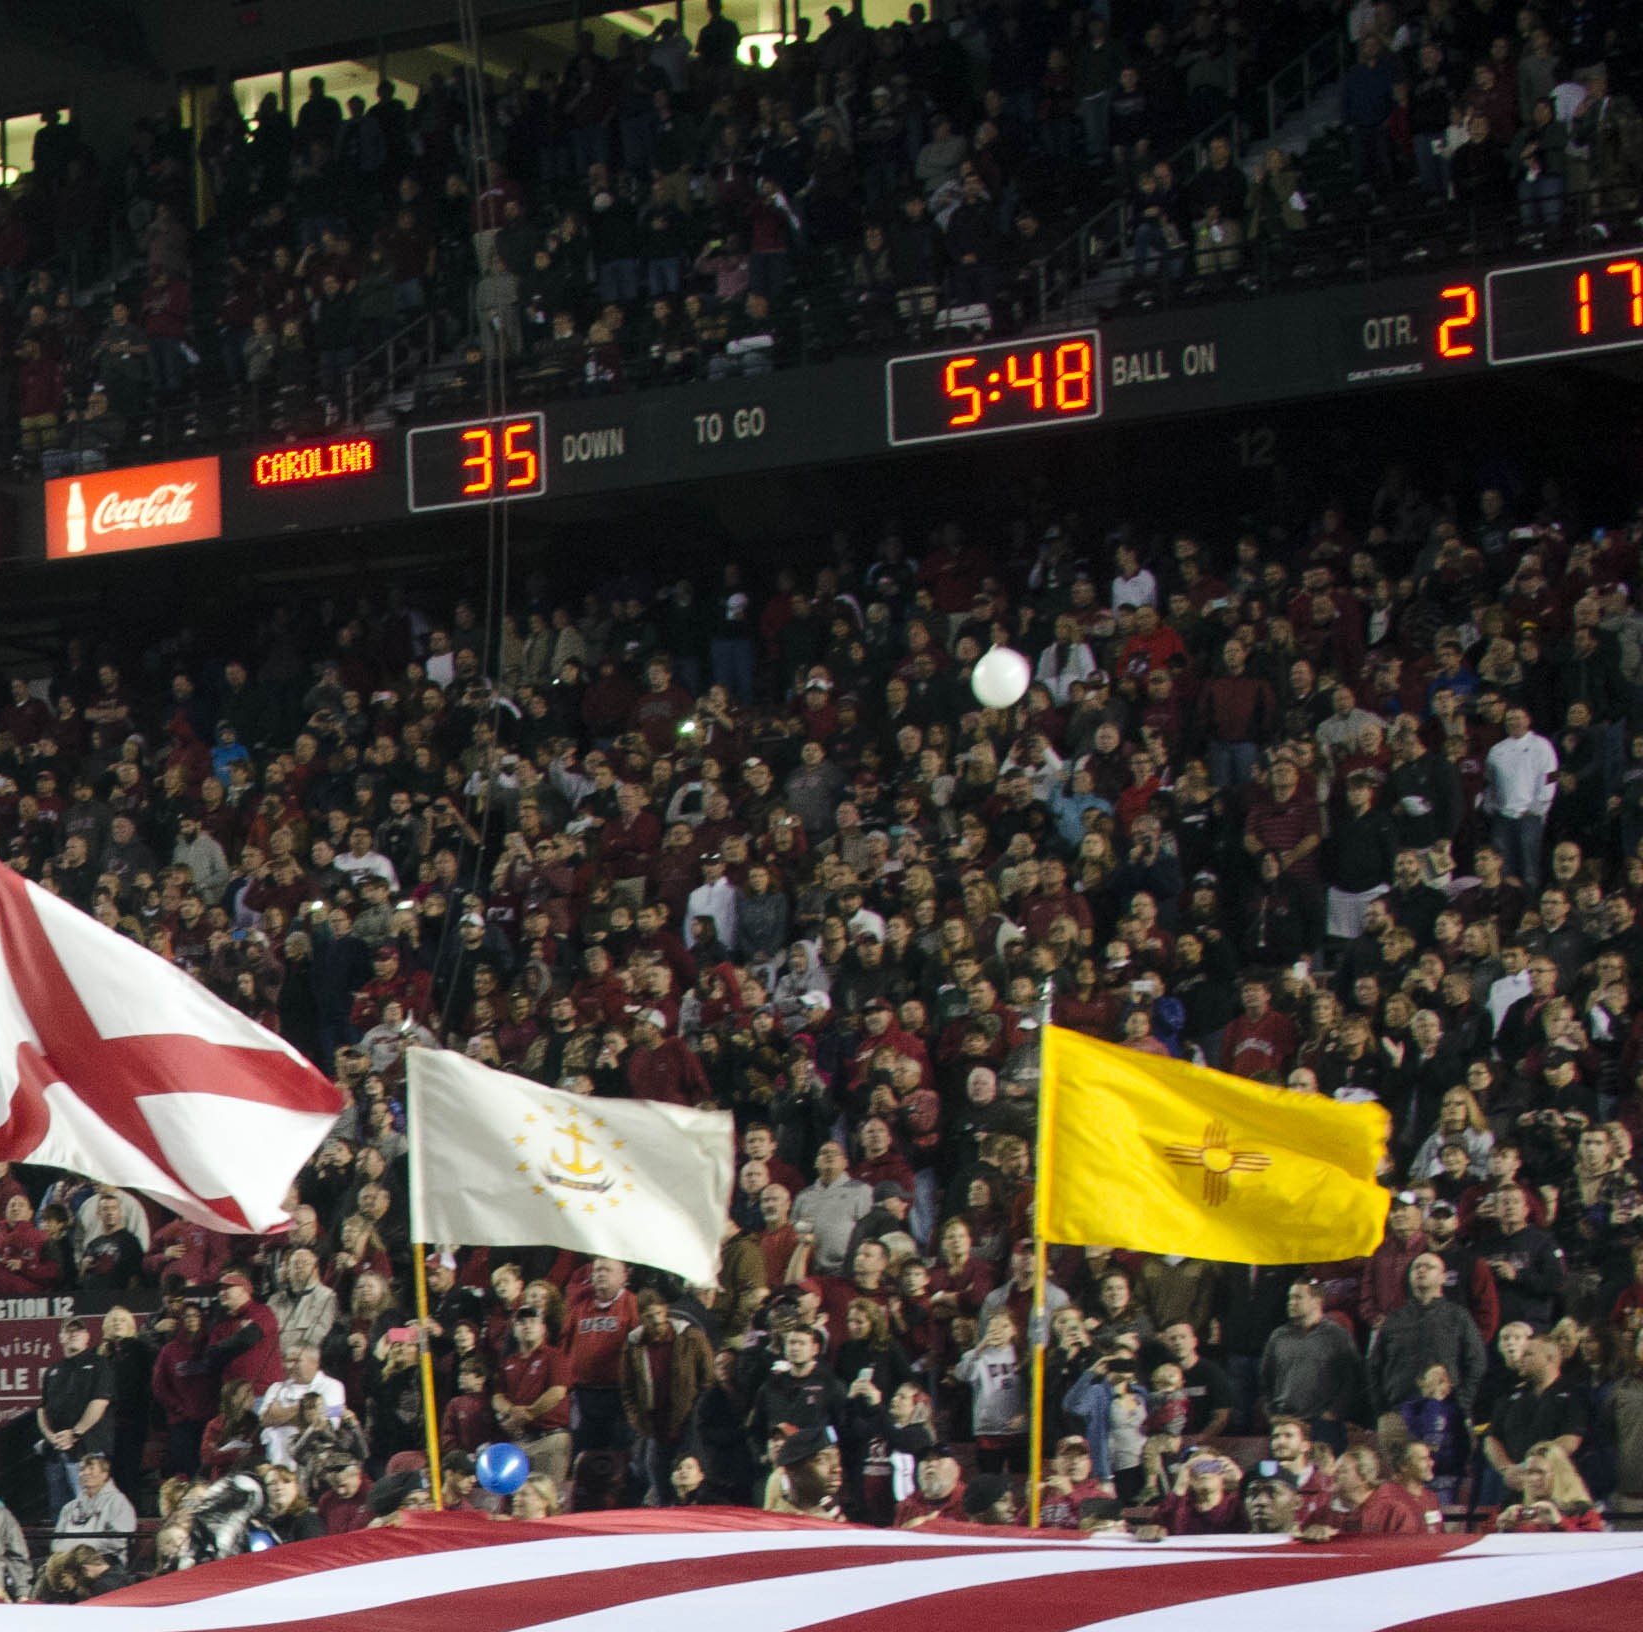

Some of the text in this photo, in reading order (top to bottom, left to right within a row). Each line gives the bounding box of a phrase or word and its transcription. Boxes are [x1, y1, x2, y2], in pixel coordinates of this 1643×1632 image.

[1576, 259, 1643, 337] 17
[1364, 314, 1419, 350] QTR.
[1437, 285, 1477, 358] 2
[944, 340, 1093, 427] 5:48
[1111, 341, 1217, 387] BALL ON
[561, 427, 626, 465] DOWN
[693, 405, 767, 445] TO GO
[254, 440, 374, 487] CAROLINA
[459, 420, 540, 496] 35
[53, 1295, 76, 1318] 12
[0, 1336, 53, 1359] visit
